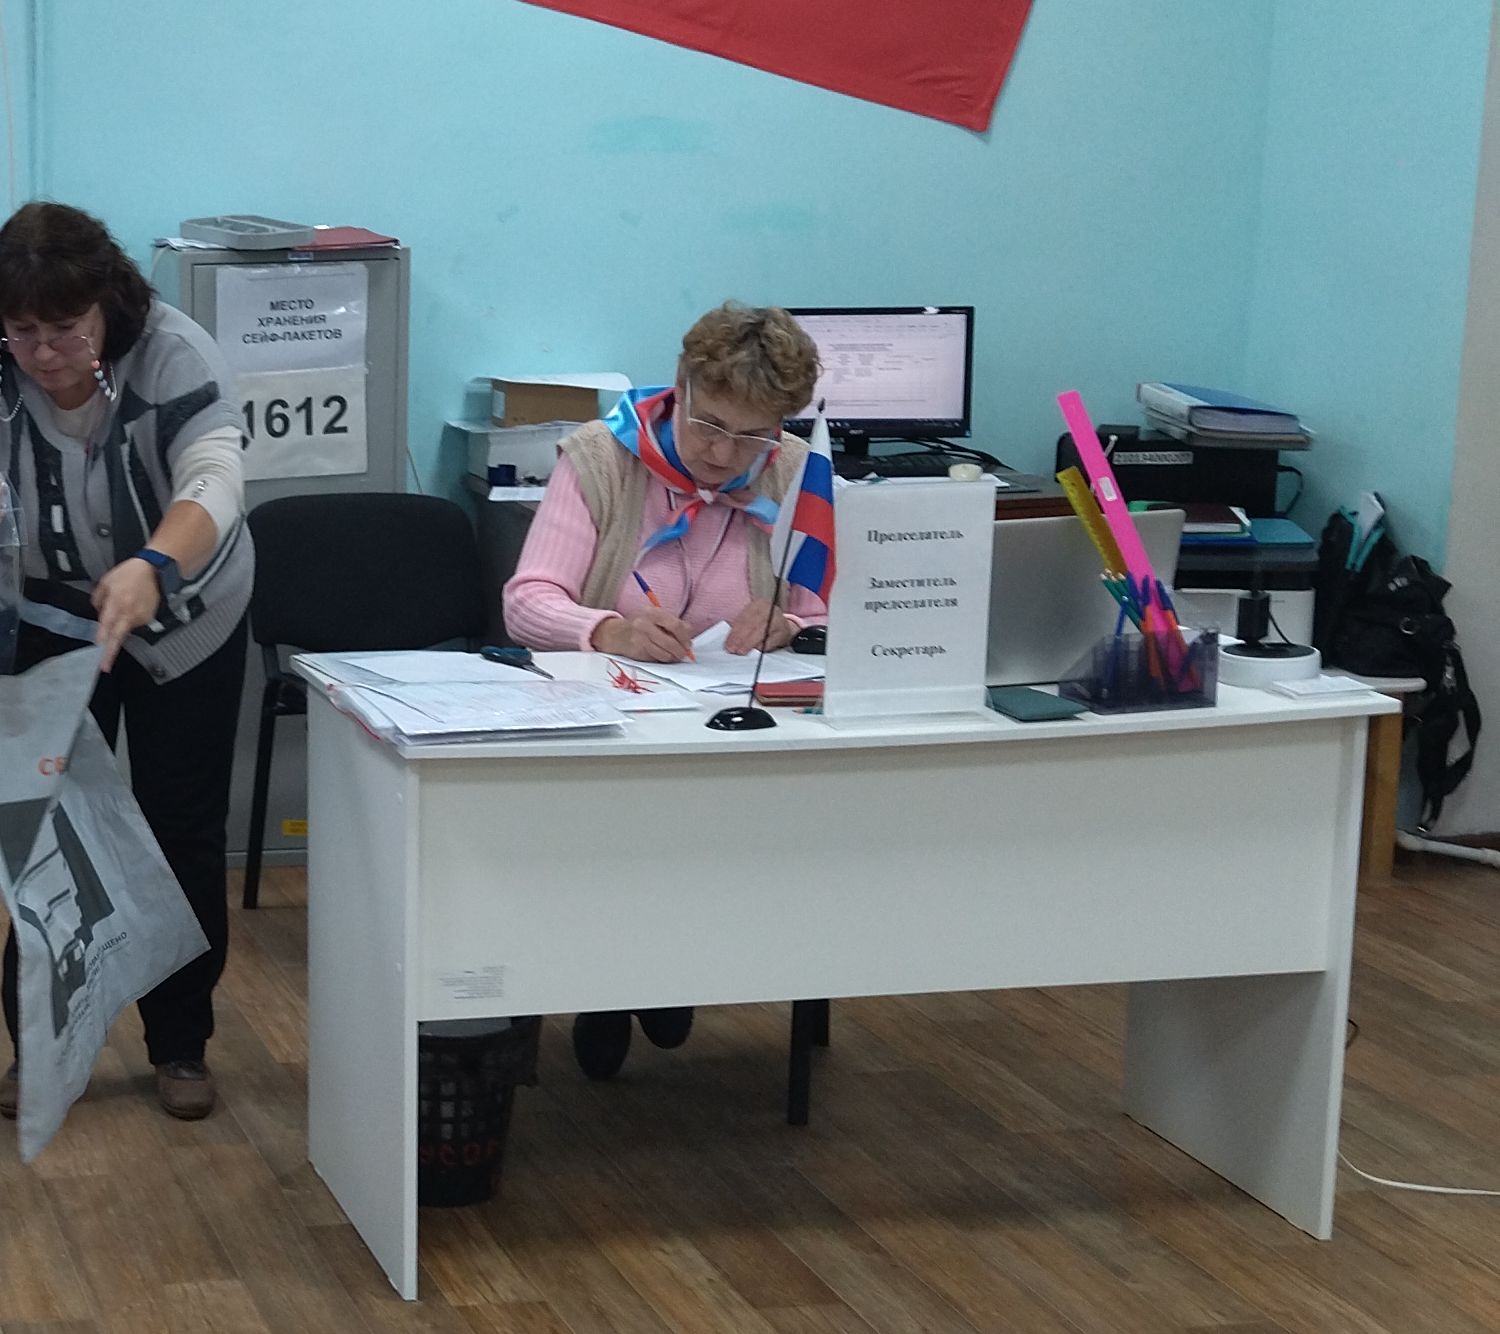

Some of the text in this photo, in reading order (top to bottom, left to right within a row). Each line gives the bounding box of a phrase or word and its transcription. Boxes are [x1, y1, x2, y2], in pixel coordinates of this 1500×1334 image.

[269, 298, 315, 311] МЕСТО
[257, 314, 327, 327] ХРАНЕНИЯ
[242, 328, 342, 344] СЕЙФ-ПАКЕТОВ
[242, 395, 348, 439] 1612
[866, 529, 964, 545] Председатель
[868, 576, 957, 589] Заместитель
[864, 597, 958, 613] председателя
[871, 644, 947, 659] Секретарь
